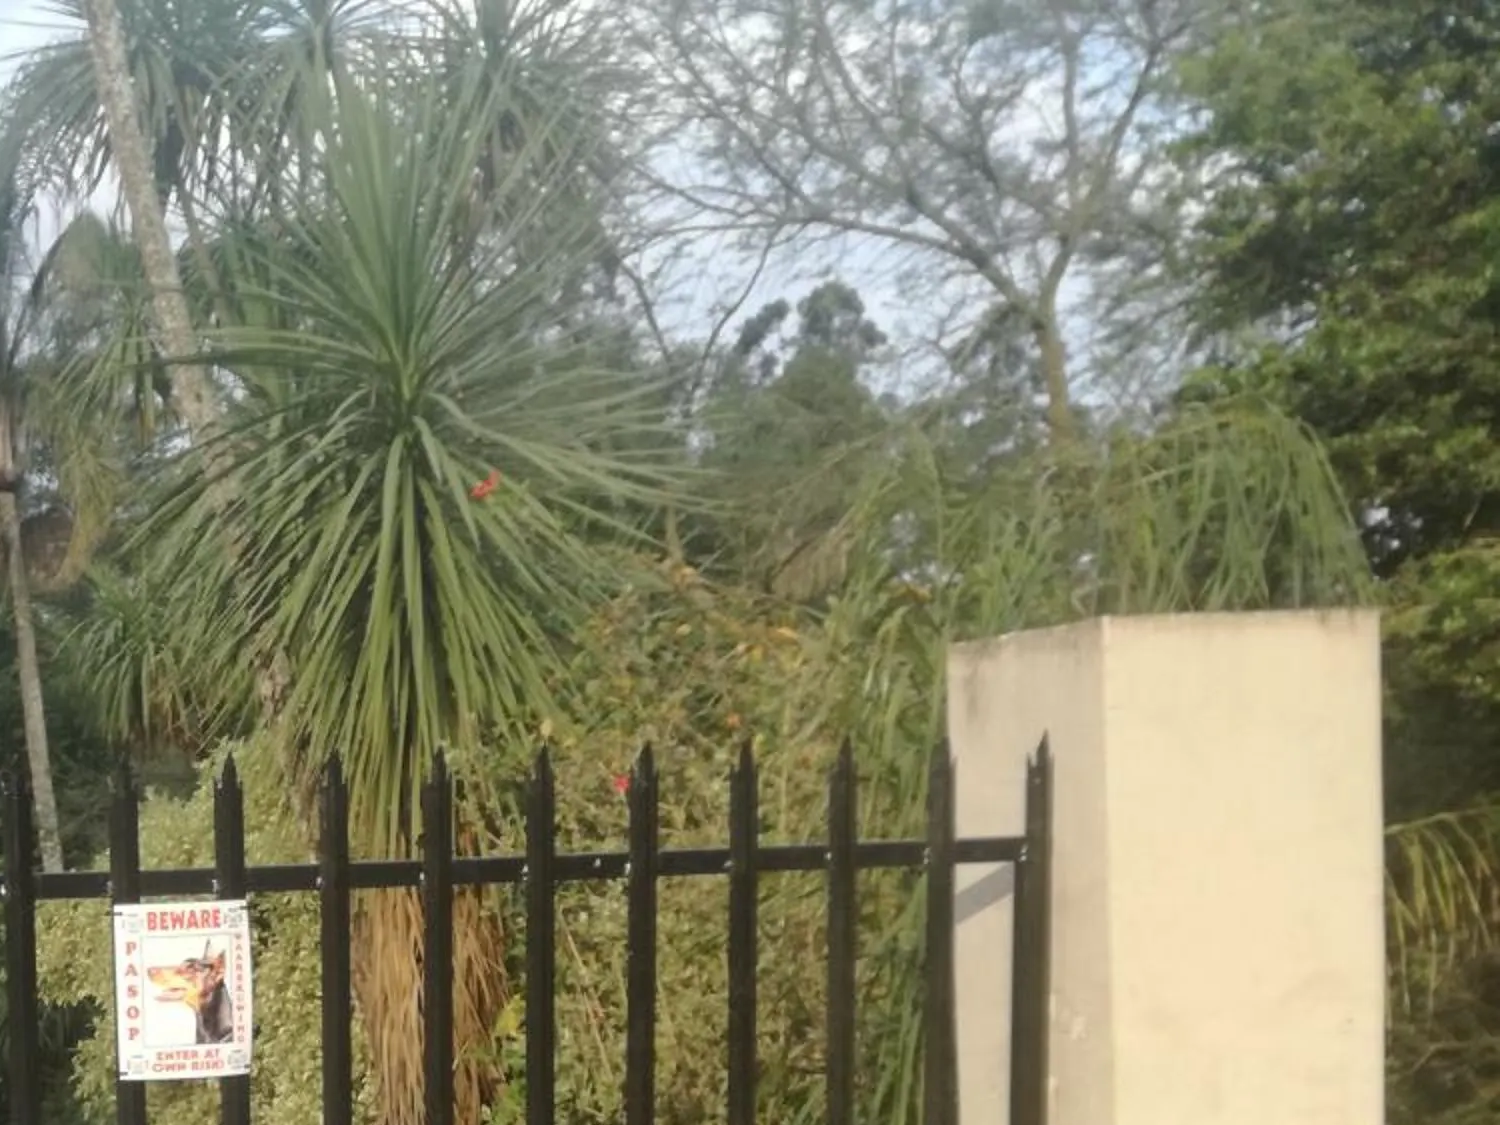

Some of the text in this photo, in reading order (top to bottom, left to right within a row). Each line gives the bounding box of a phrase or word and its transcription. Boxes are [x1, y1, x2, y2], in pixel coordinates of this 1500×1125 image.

[146, 908, 222, 931] BEWARE
[124, 941, 141, 1042] PASOP
[155, 1048, 220, 1061] ENTER AT
